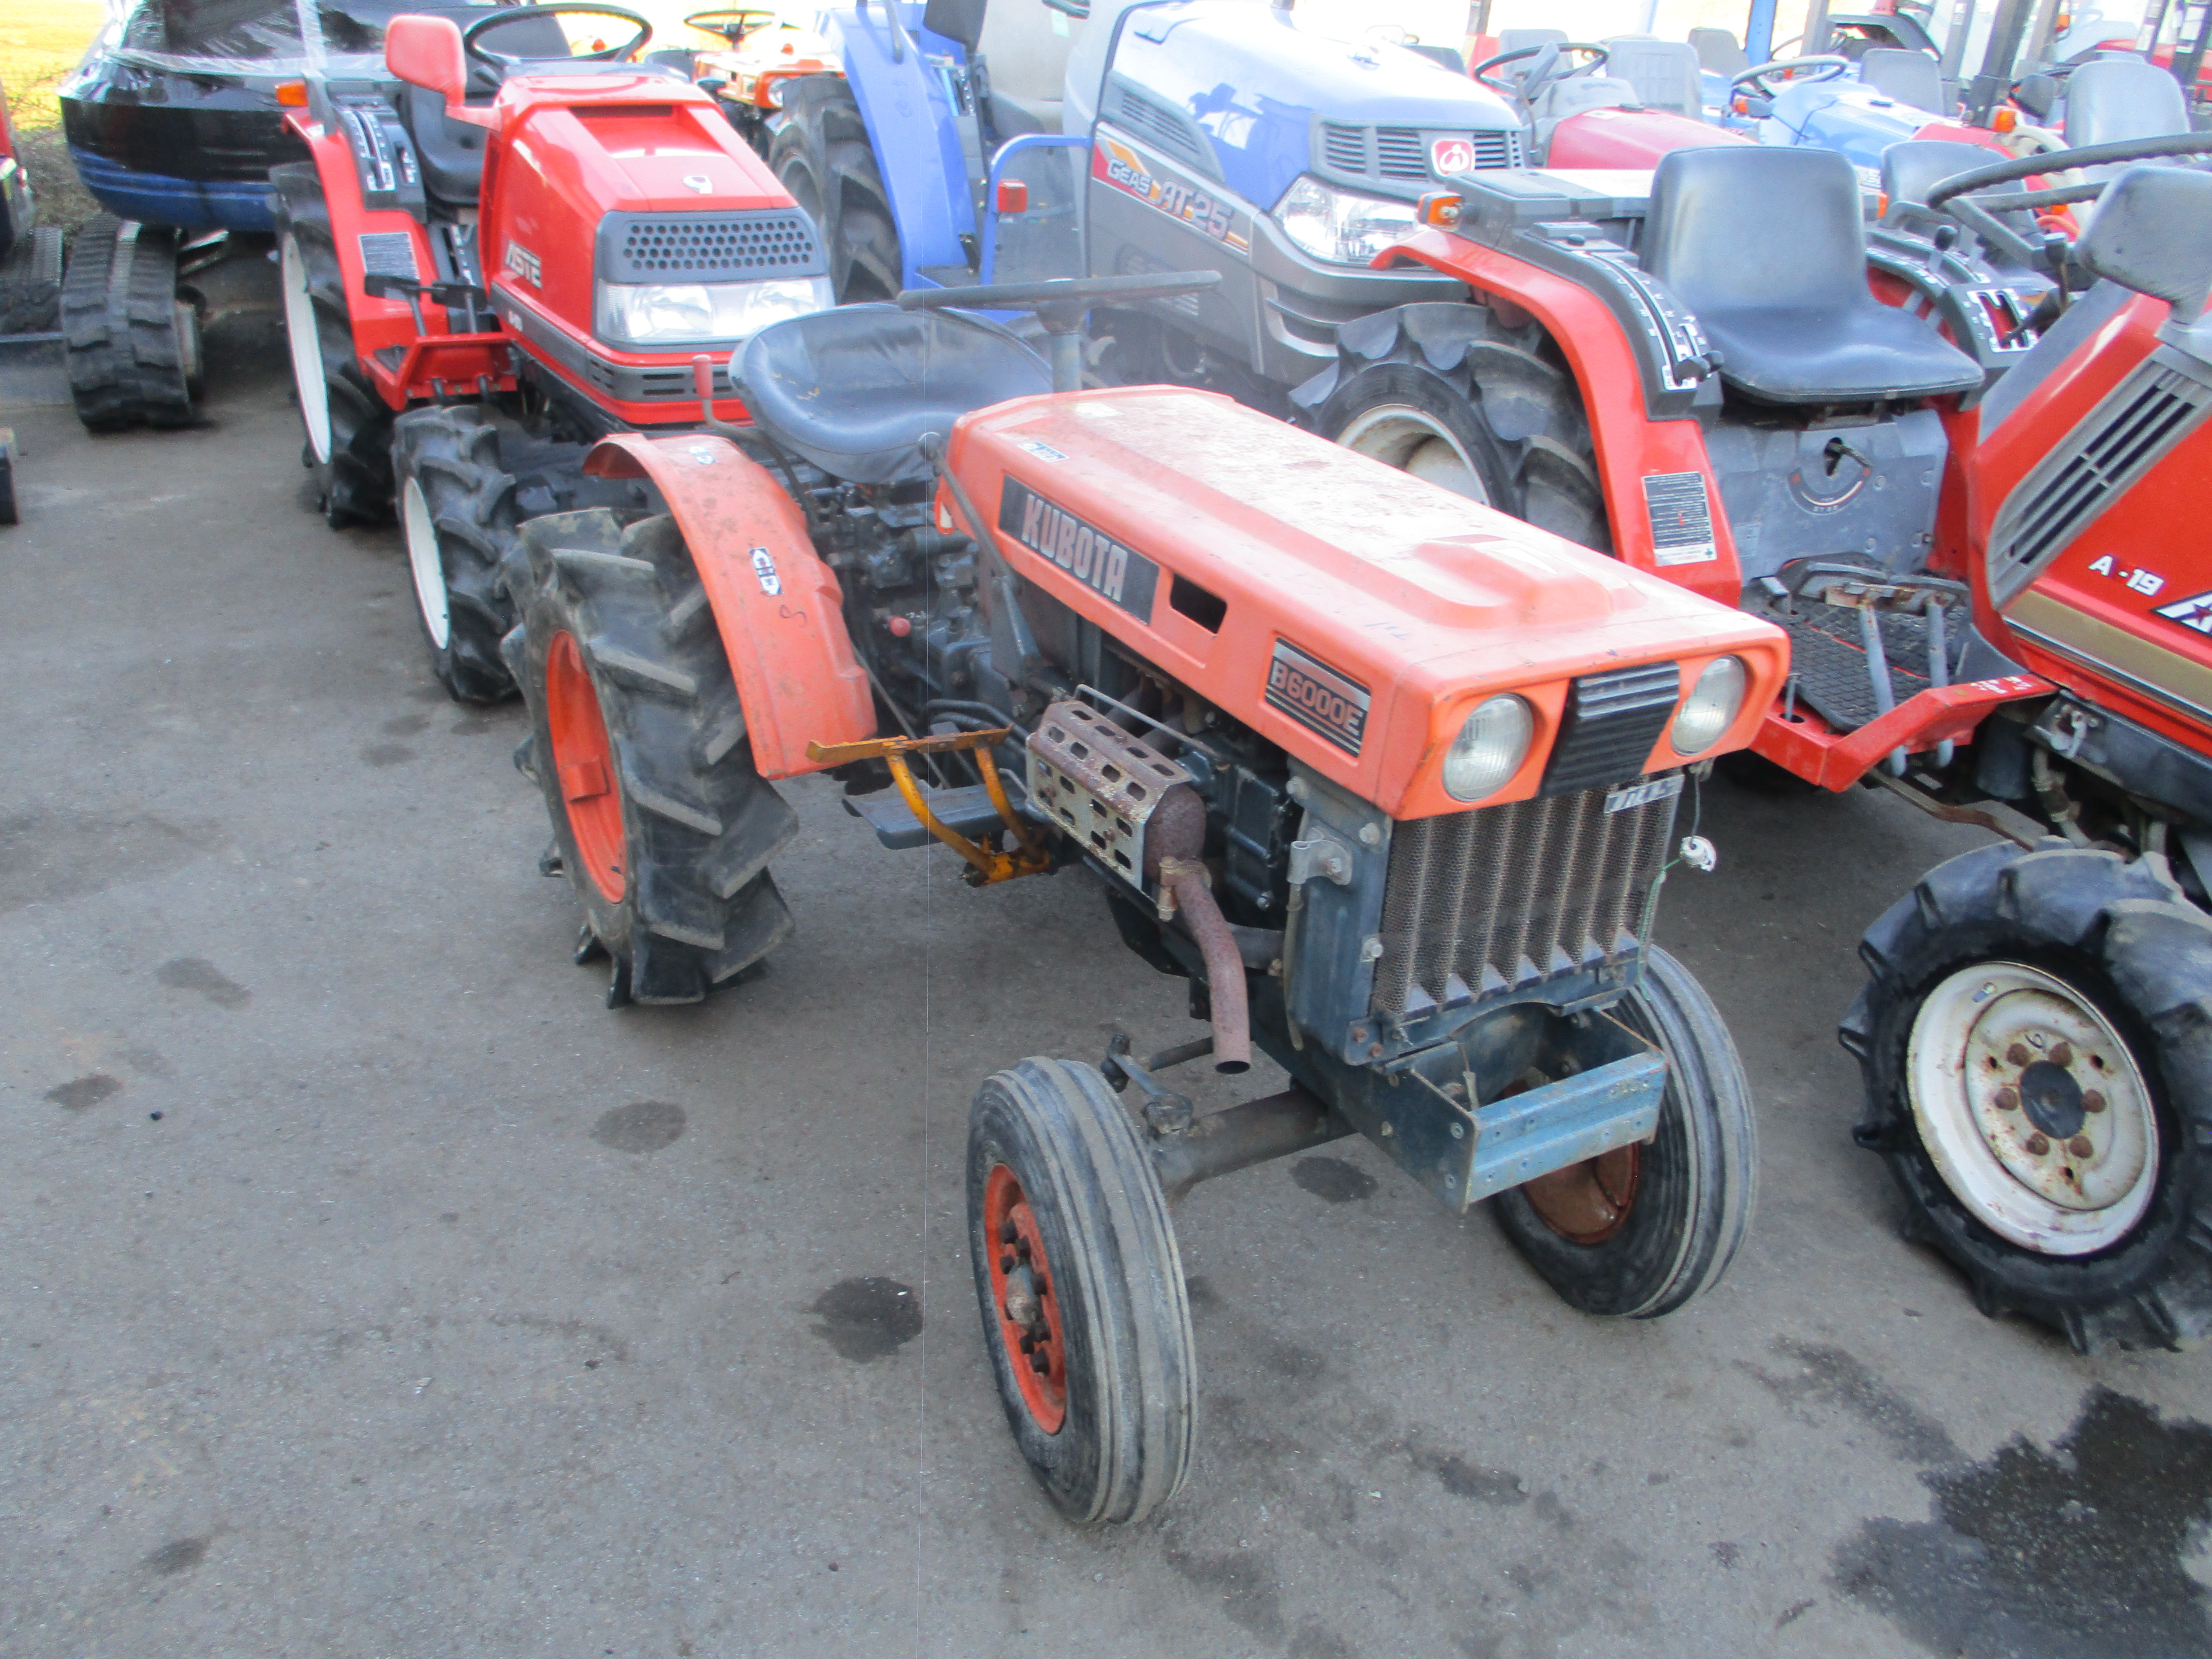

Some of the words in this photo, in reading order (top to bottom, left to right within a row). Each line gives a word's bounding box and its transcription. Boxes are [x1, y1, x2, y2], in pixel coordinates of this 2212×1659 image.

[1107, 159, 1152, 194] GEAS
[1021, 494, 1128, 602] KUBOTA
[1270, 660, 1364, 737] B6000E
